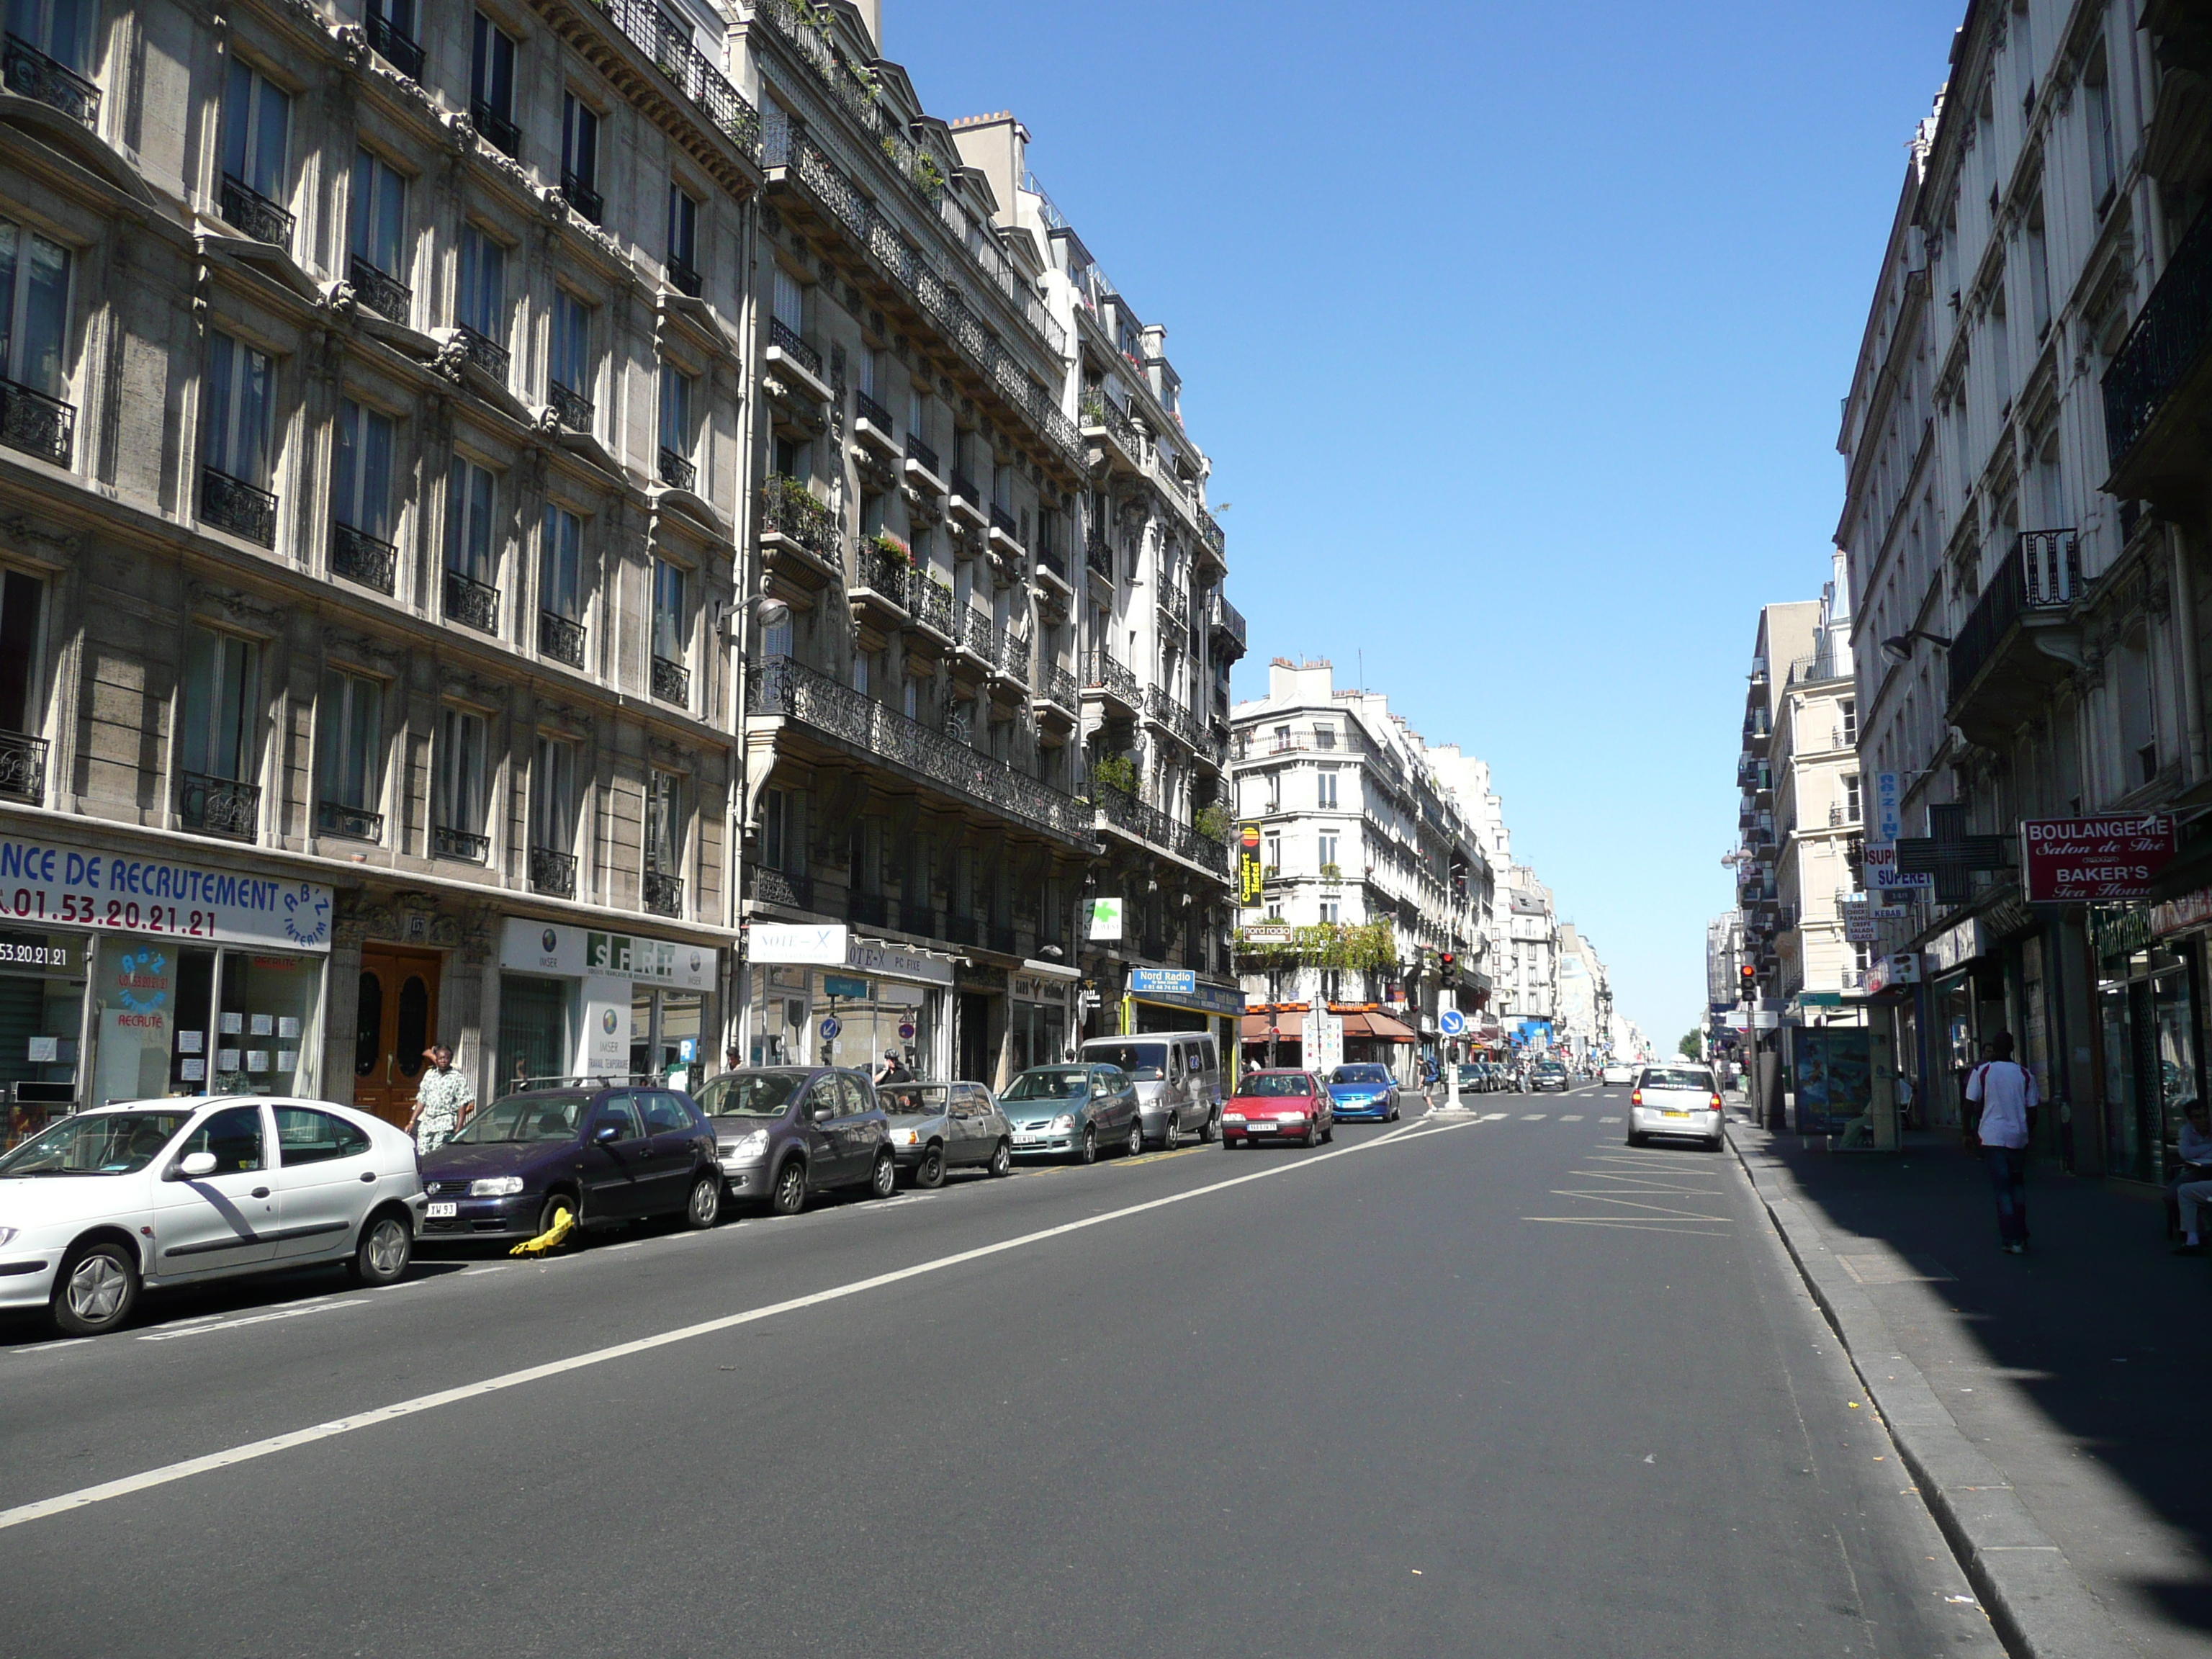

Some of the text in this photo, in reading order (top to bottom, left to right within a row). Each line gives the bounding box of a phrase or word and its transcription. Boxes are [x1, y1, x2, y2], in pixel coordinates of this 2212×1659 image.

[2029, 819, 2169, 841] BOULANGERIE
[2036, 837, 2166, 855] Salon de Thé
[1, 842, 279, 912] NCE DE RECRUTEMENT
[1241, 853, 1251, 902] Comfort
[1251, 862, 1260, 893] Hotel
[2056, 865, 2149, 883] BAKER'S
[2052, 884, 2087, 899] Tea
[14, 888, 215, 938] 01.53.20.21.21
[284, 918, 326, 947] INTERIM
[1245, 926, 1290, 935] nord radio
[894, 956, 904, 968] PC
[907, 957, 921, 971] FIXE
[1493, 928, 1501, 989] HOTEL
[1140, 971, 1191, 981] Nord Radio
[117, 1015, 163, 1028] RECRUTE
